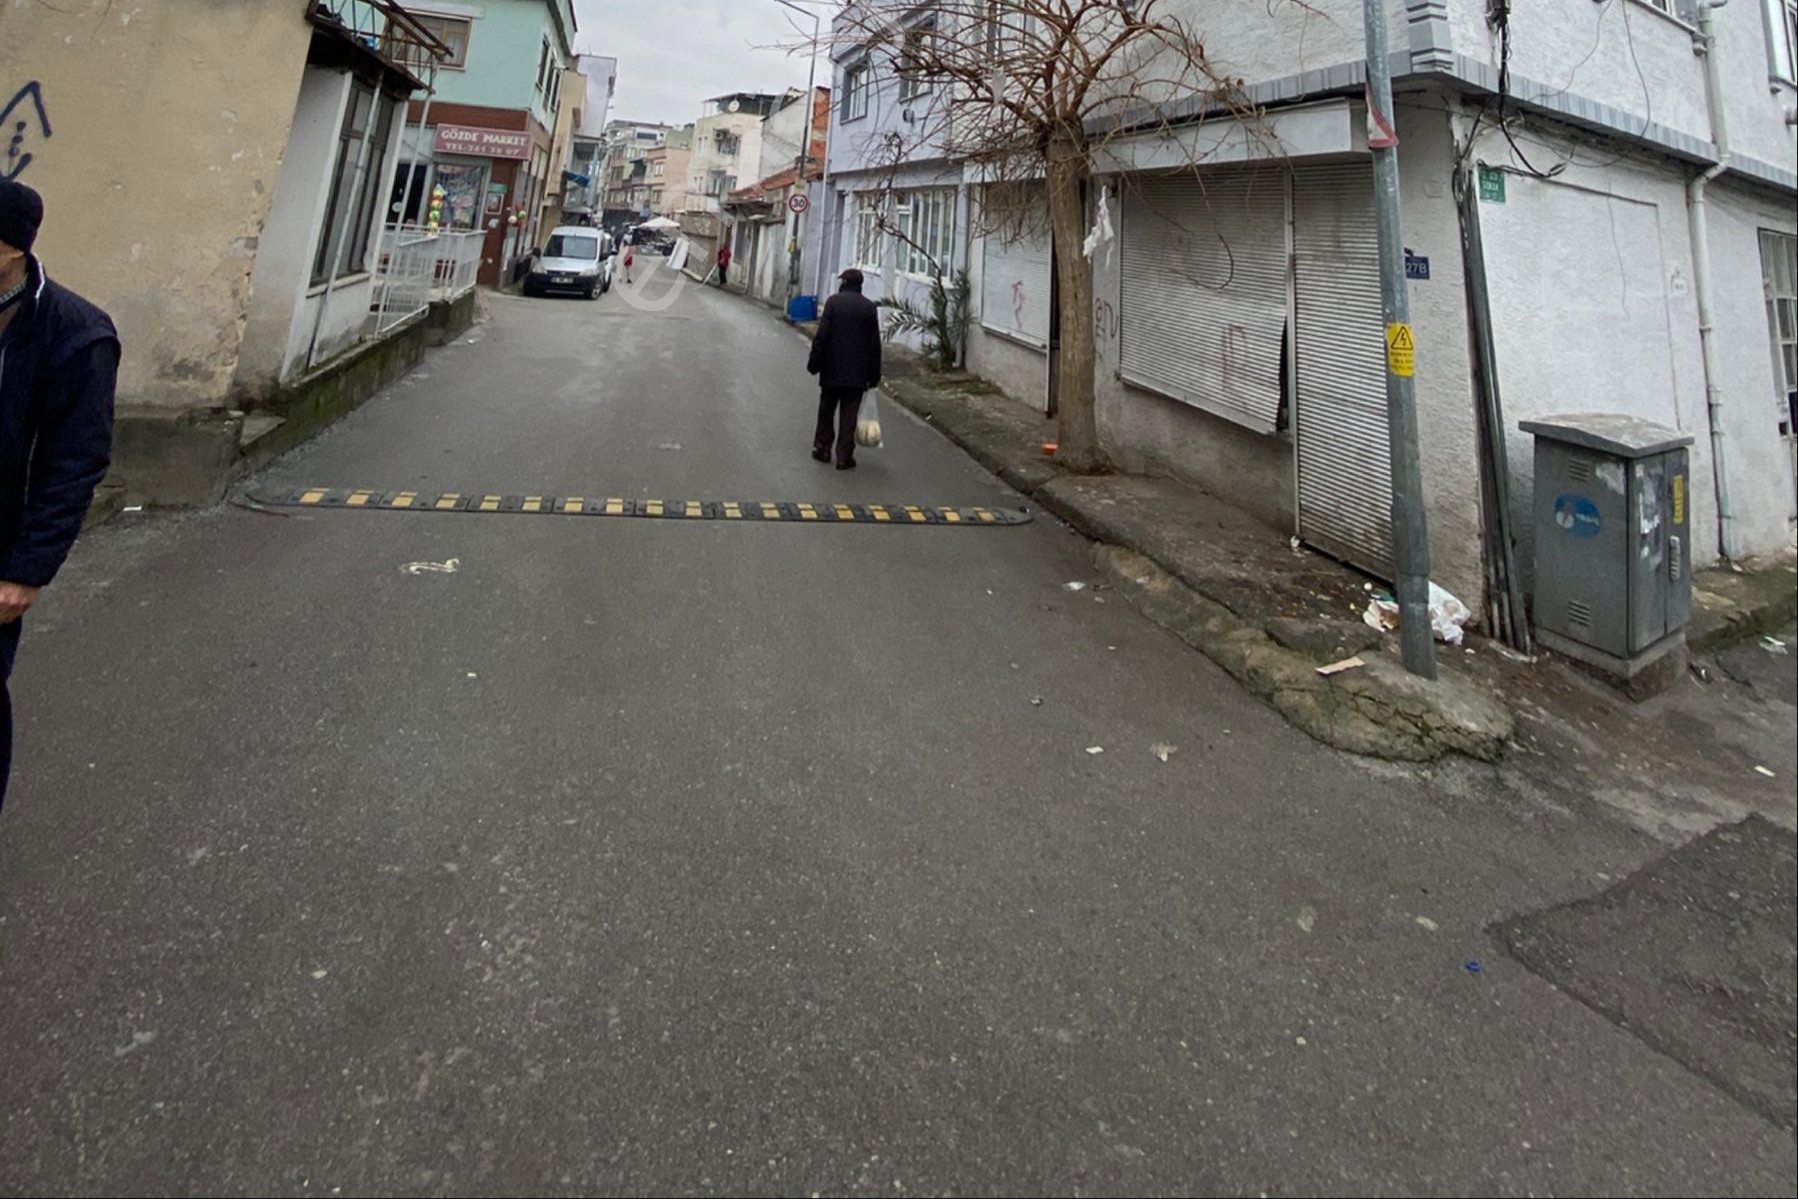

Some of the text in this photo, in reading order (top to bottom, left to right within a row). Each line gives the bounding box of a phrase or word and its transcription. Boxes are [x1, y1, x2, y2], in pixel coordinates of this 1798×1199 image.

[442, 128, 528, 146] GÖZDE MARKET
[793, 198, 805, 208] 30
[1406, 263, 1427, 274] 27B
